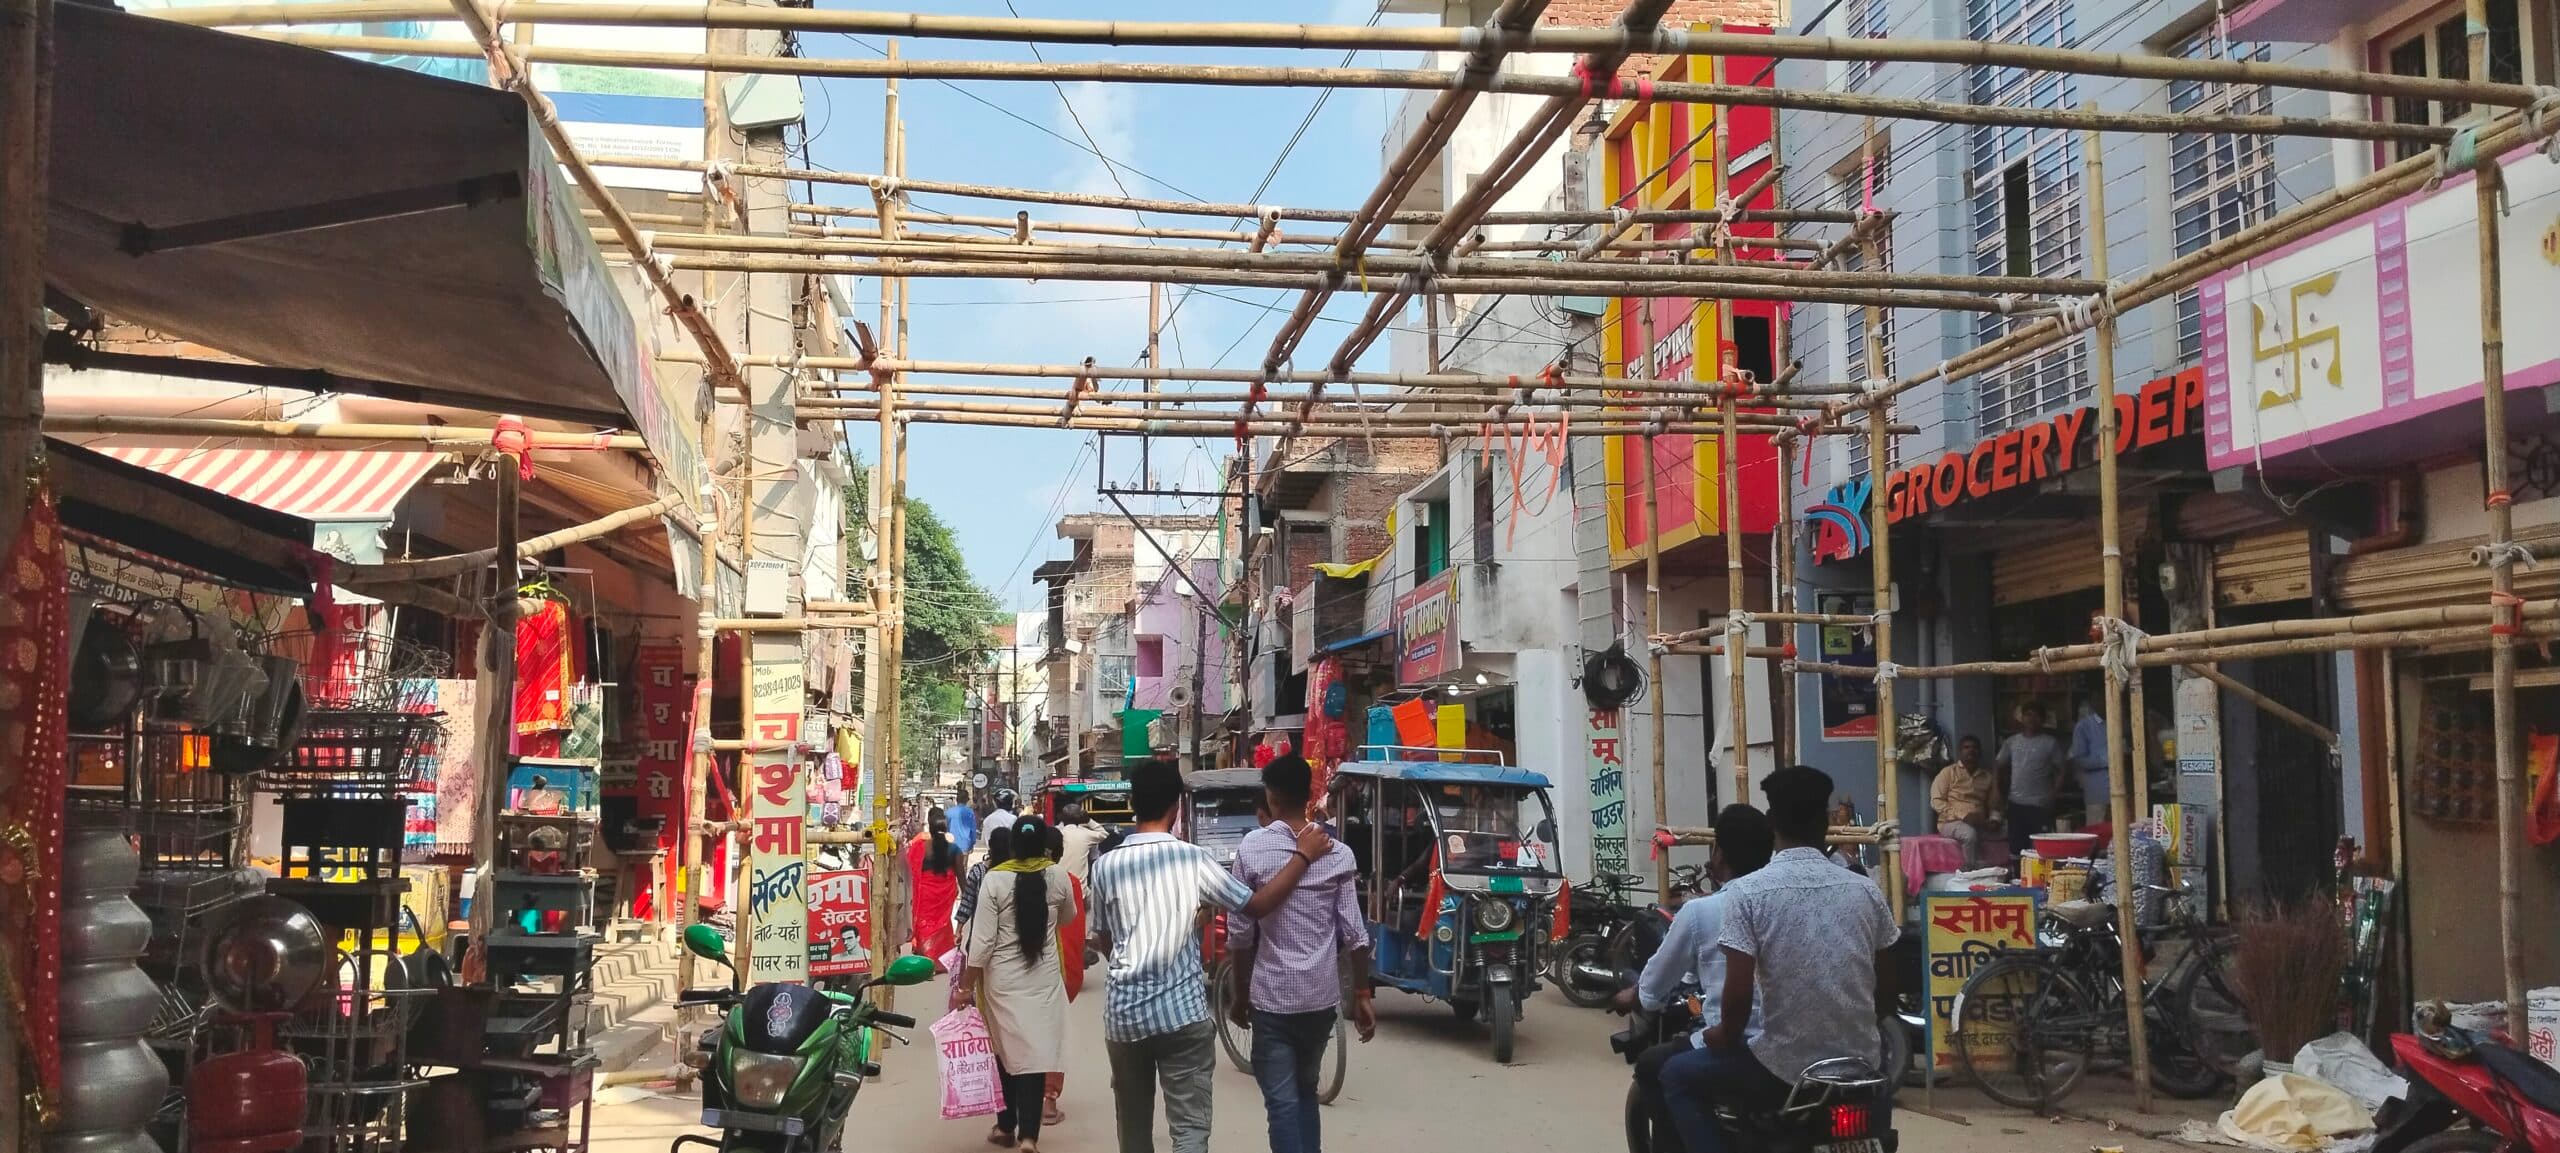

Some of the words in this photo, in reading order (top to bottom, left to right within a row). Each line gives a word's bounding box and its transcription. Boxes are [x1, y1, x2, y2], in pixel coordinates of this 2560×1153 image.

[1884, 407, 2088, 527] GROCERY
[2183, 814, 2195, 861] fortune
[1932, 896, 2035, 946] सोमू
